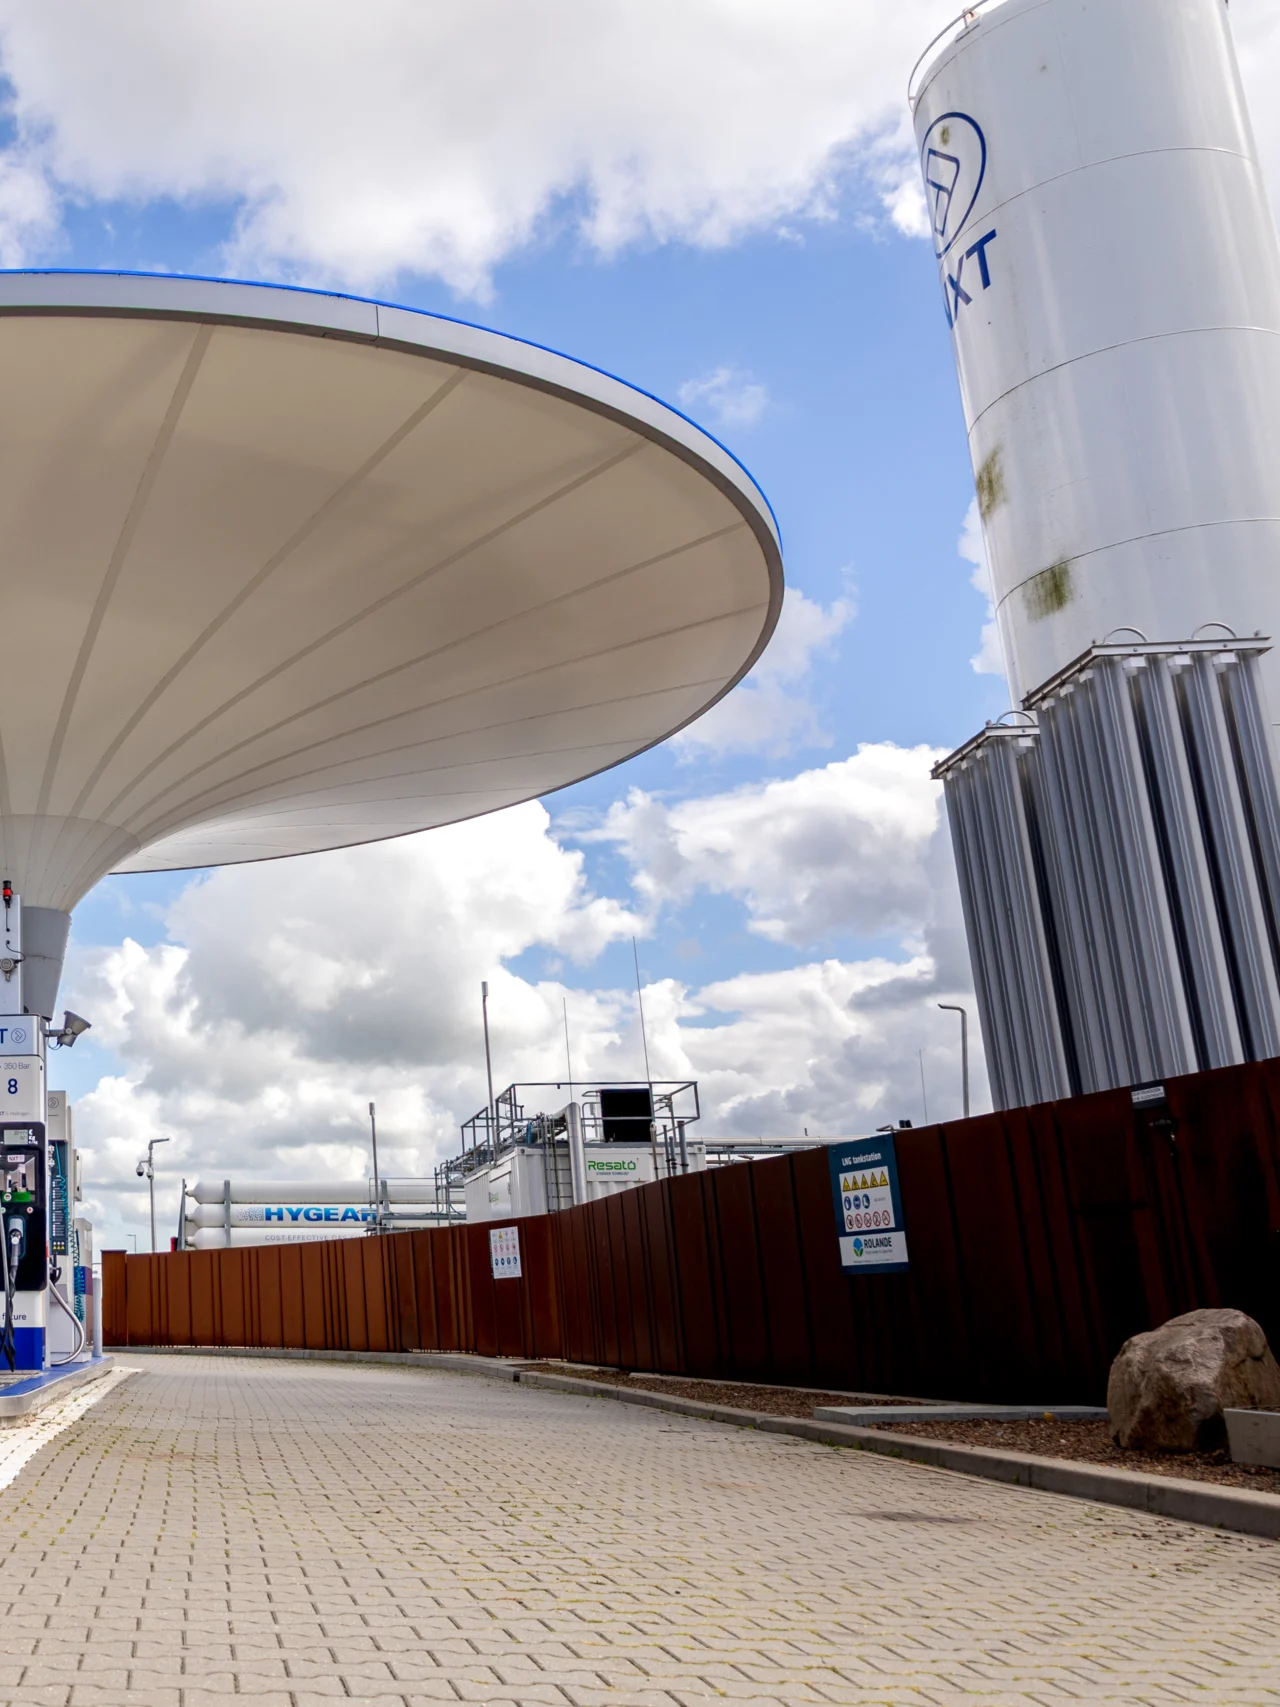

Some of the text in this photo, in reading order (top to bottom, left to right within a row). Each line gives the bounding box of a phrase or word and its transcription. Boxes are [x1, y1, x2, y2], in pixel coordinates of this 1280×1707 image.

[18, 1062, 31, 1070] Bar
[8, 1078, 18, 1095] 8
[852, 1152, 881, 1165] tankstation
[588, 1160, 636, 1170] Resato
[864, 1237, 892, 1249] ROLANDE
